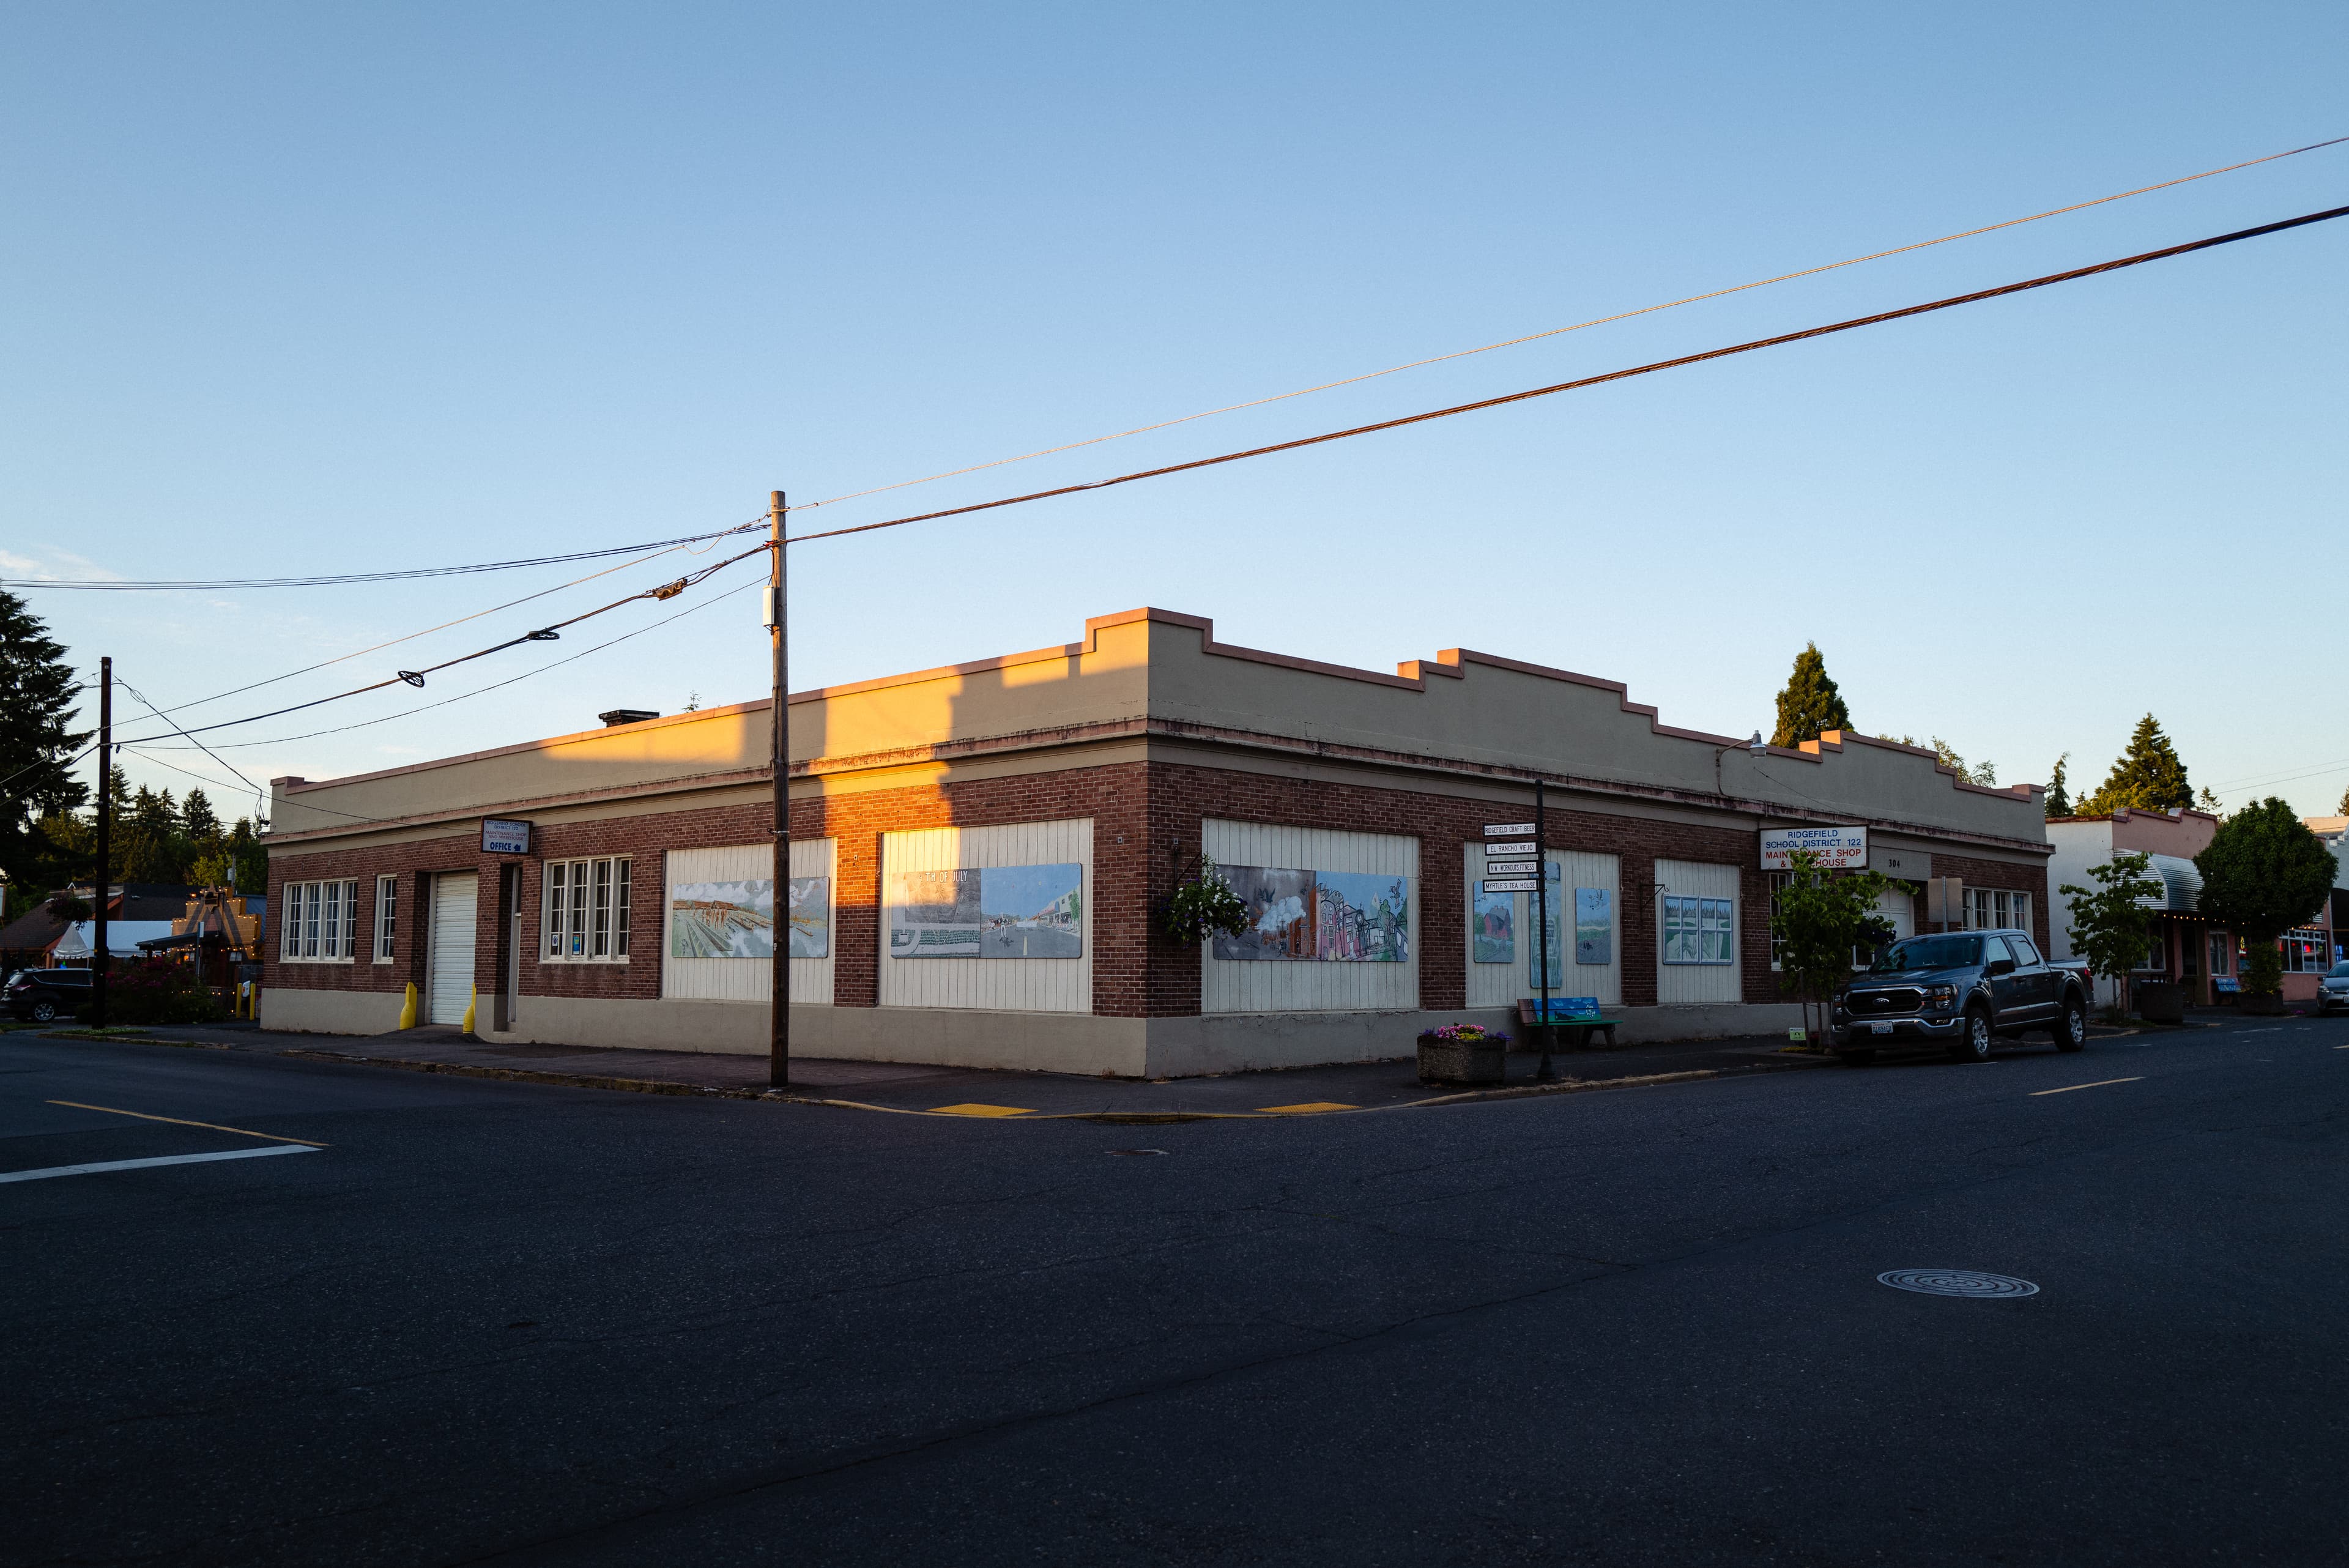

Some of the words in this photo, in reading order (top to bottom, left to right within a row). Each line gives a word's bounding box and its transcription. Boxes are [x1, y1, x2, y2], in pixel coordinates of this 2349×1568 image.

[1787, 830, 1838, 838] RIDGEFIELD
[490, 842, 511, 851] OFFICE
[1765, 840, 1799, 849] SCHOOL
[1803, 839, 1841, 847] DISTRICT
[1836, 849, 1861, 857] SHOP
[1888, 859, 1900, 868] 304
[939, 871, 948, 882] OF
[952, 871, 968, 882] JULY
